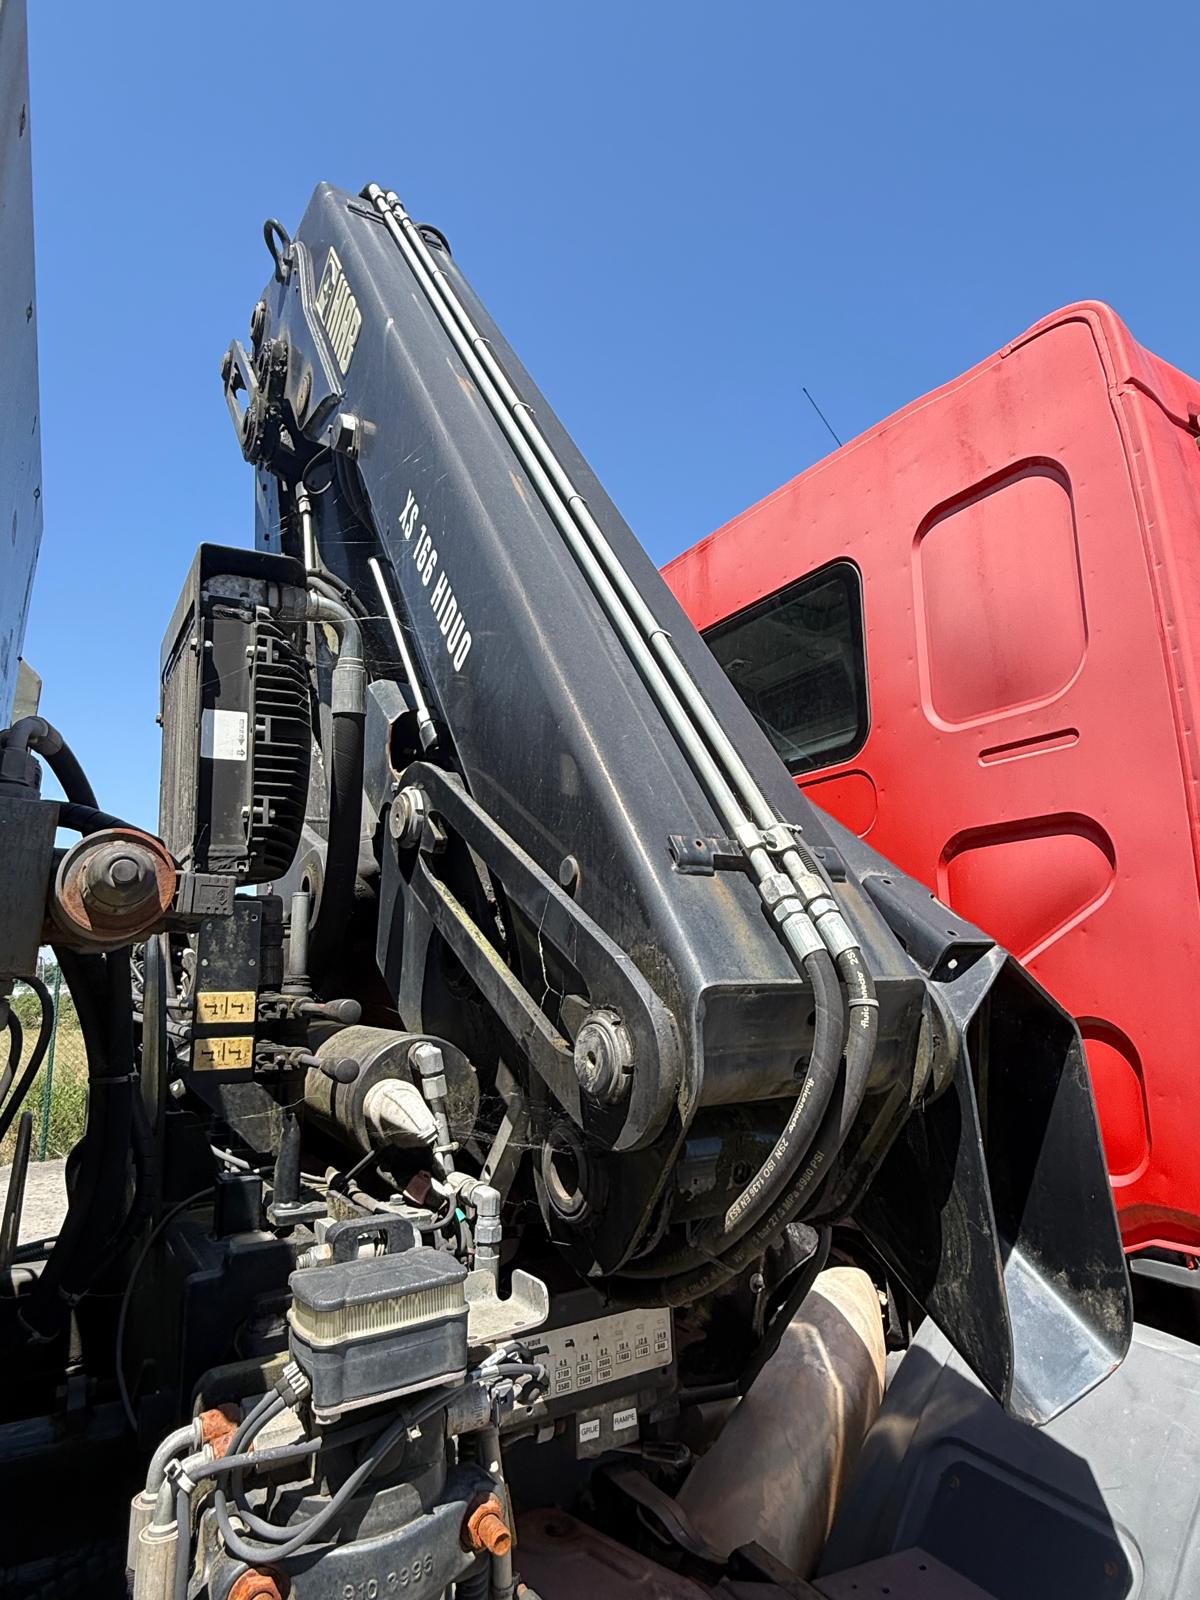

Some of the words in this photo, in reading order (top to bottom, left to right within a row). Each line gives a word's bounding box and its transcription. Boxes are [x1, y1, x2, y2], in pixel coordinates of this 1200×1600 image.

[324, 272, 362, 376] HIAB
[398, 488, 419, 540] XS
[412, 524, 438, 587] 166
[430, 570, 472, 672] HIDUO
[857, 970, 870, 1030] fluicnnecto
[774, 1137, 789, 1160] 2SN
[763, 1161, 777, 1178] ISO
[749, 1177, 765, 1197] 1436
[783, 1189, 800, 1214] MPa
[810, 1150, 825, 1169] PSI
[738, 1193, 752, 1210] EN
[614, 1412, 636, 1425] RAMPE
[580, 1424, 600, 1436] GRUE
